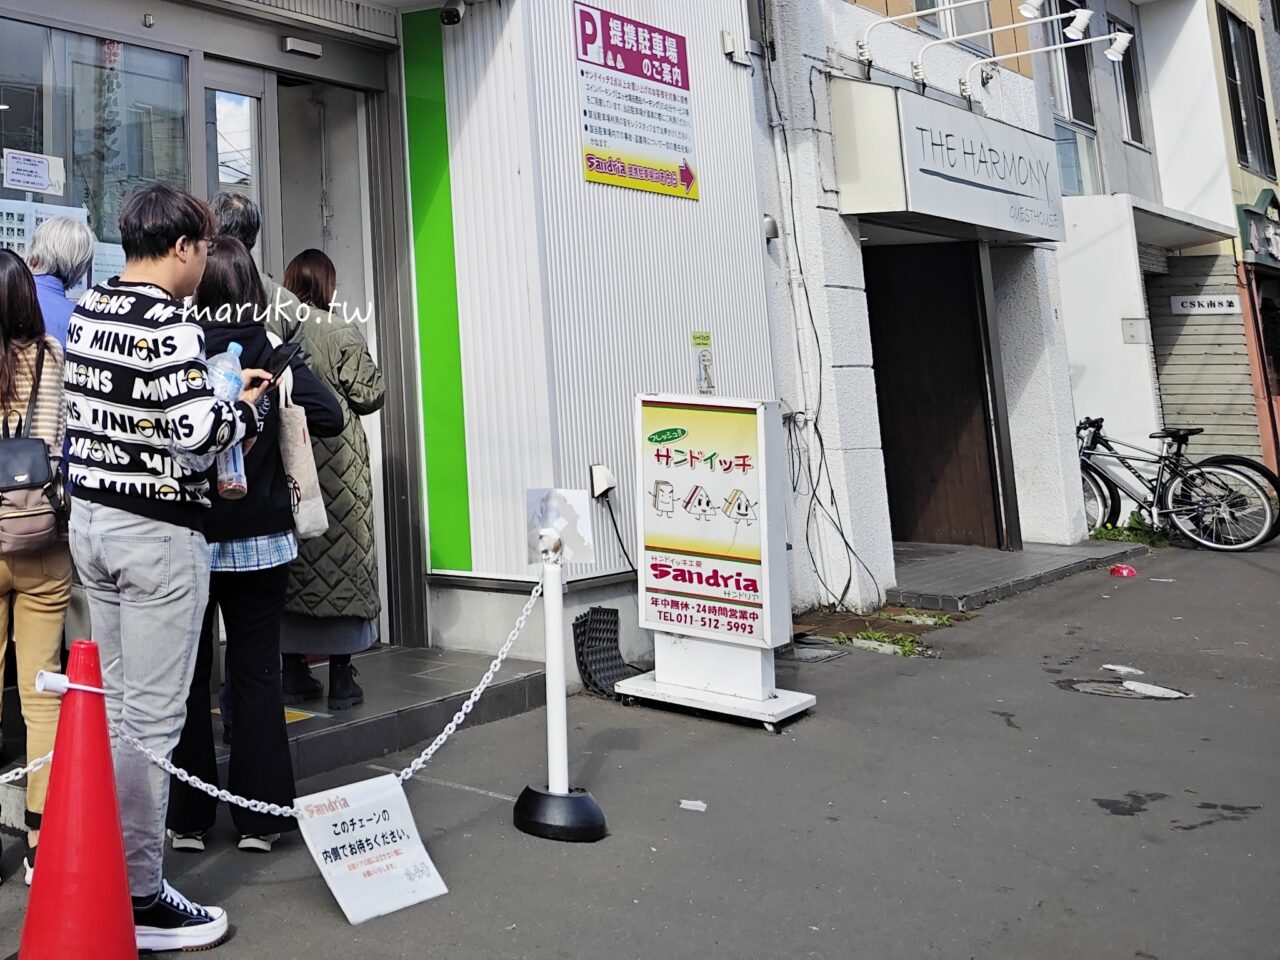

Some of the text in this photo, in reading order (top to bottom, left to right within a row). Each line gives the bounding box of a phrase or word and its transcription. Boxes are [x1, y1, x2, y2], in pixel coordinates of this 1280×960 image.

[579, 9, 598, 57] P
[608, 17, 678, 64] 提携駐車場
[642, 58, 682, 86] のご案内
[915, 126, 1050, 209] THE HARMONY
[654, 447, 752, 473] サンドイッチ
[650, 563, 759, 593] Sandria
[723, 590, 759, 601] サンドリア
[304, 795, 350, 818] Sandria
[332, 809, 390, 836] このチェーンの
[322, 828, 410, 865] 内側でお待ちください。
